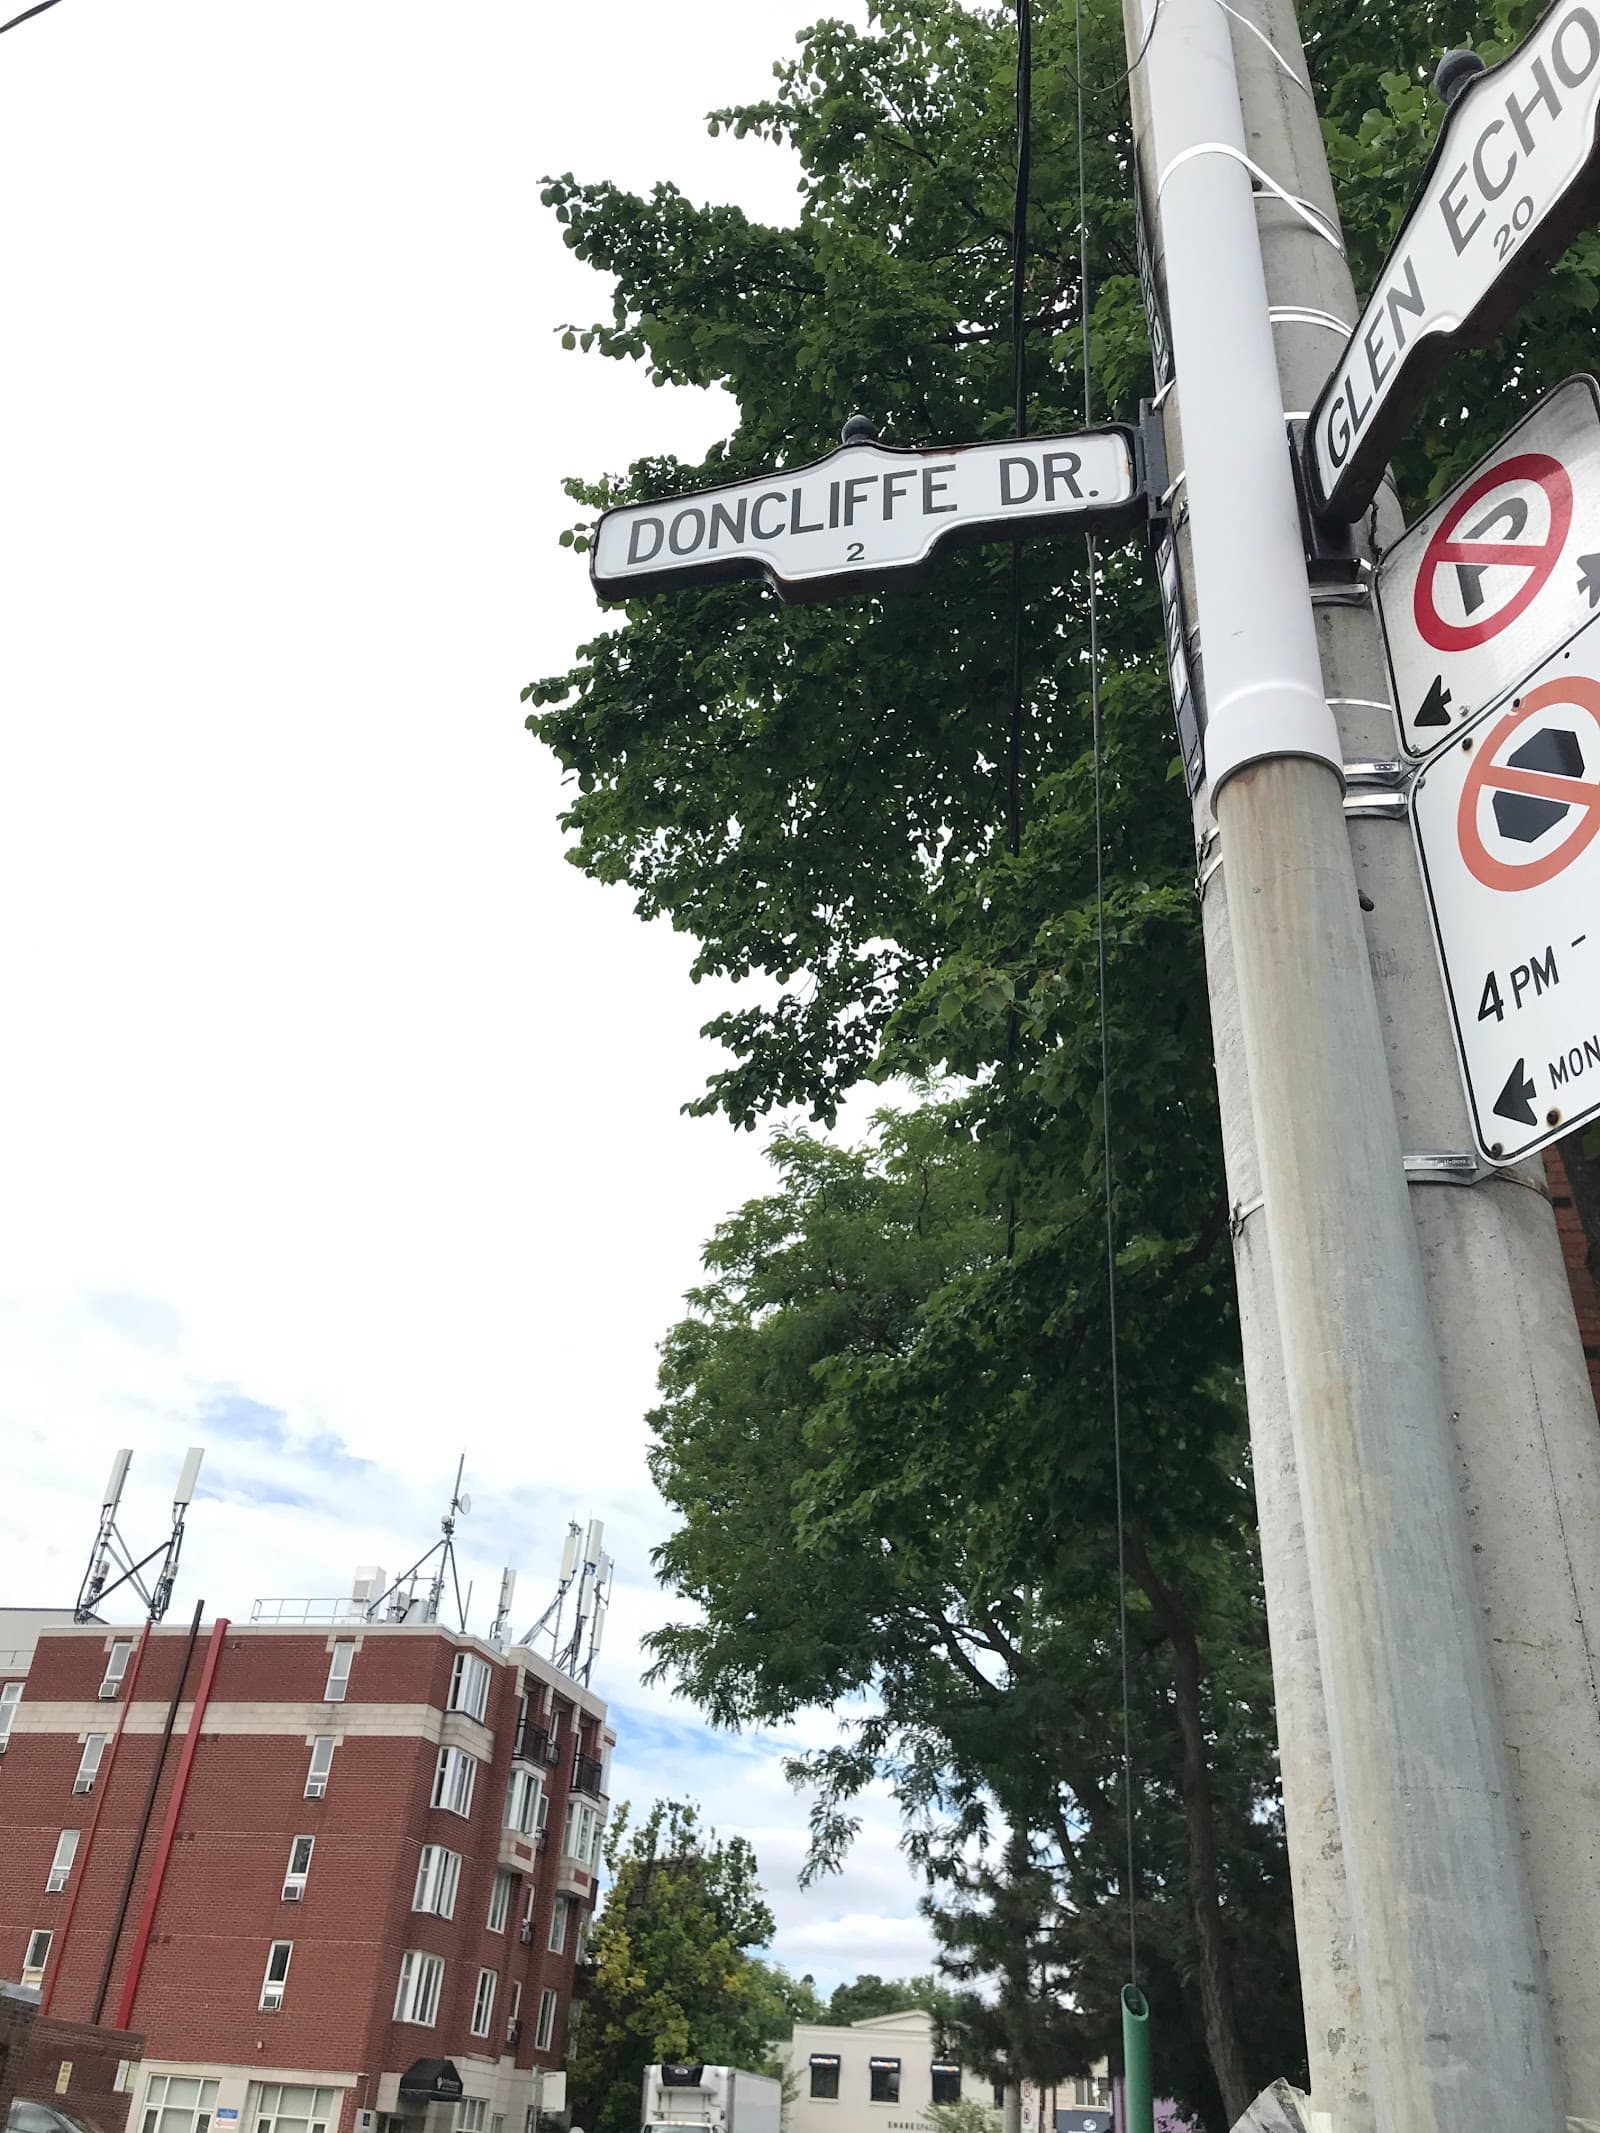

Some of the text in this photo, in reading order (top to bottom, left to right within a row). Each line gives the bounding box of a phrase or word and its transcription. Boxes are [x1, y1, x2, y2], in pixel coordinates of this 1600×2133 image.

[1327, 7, 1600, 469] GLEN ECHO
[1493, 195, 1534, 262] 20
[626, 451, 1099, 566] DONCLIFFE DR.
[846, 542, 865, 563] 2
